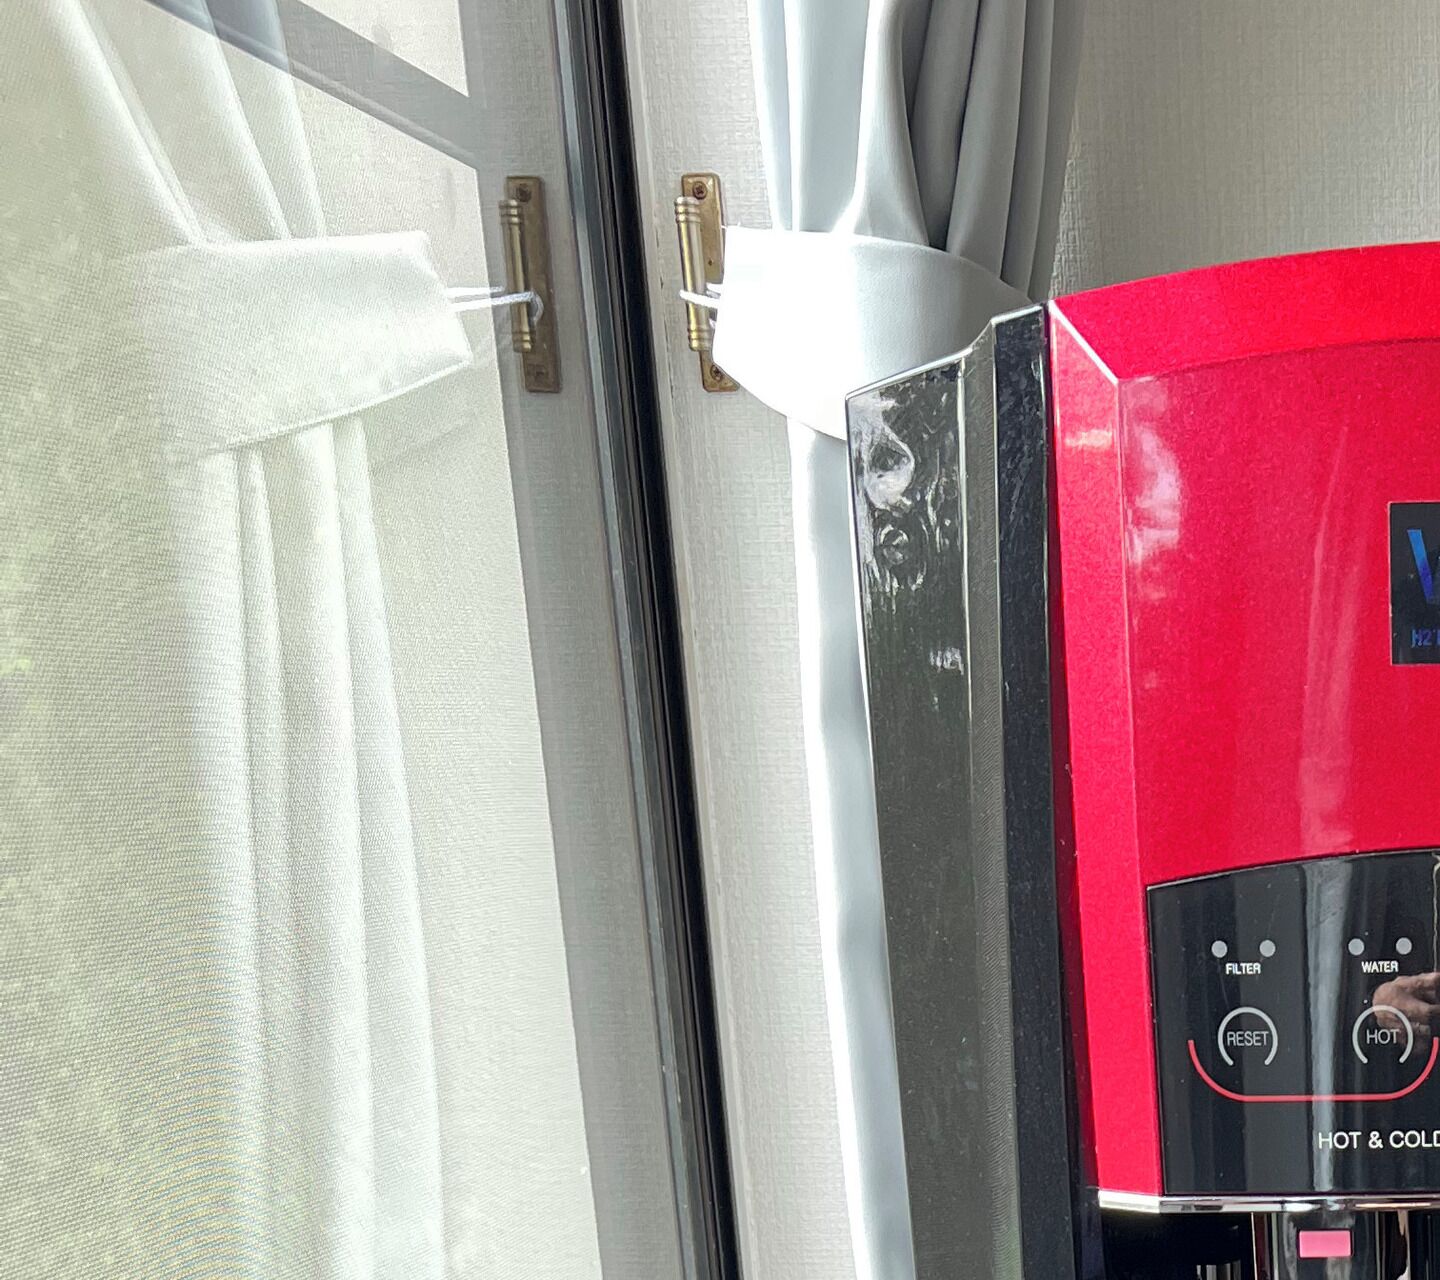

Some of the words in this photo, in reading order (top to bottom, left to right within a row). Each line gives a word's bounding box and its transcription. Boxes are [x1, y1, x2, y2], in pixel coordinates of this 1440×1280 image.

[1225, 962, 1262, 975] FILTER
[1361, 960, 1399, 974] WATER
[1226, 1031, 1270, 1047] RESET
[1366, 1028, 1400, 1045] HOT
[1318, 1132, 1361, 1150] HOT
[1368, 1132, 1383, 1149] &
